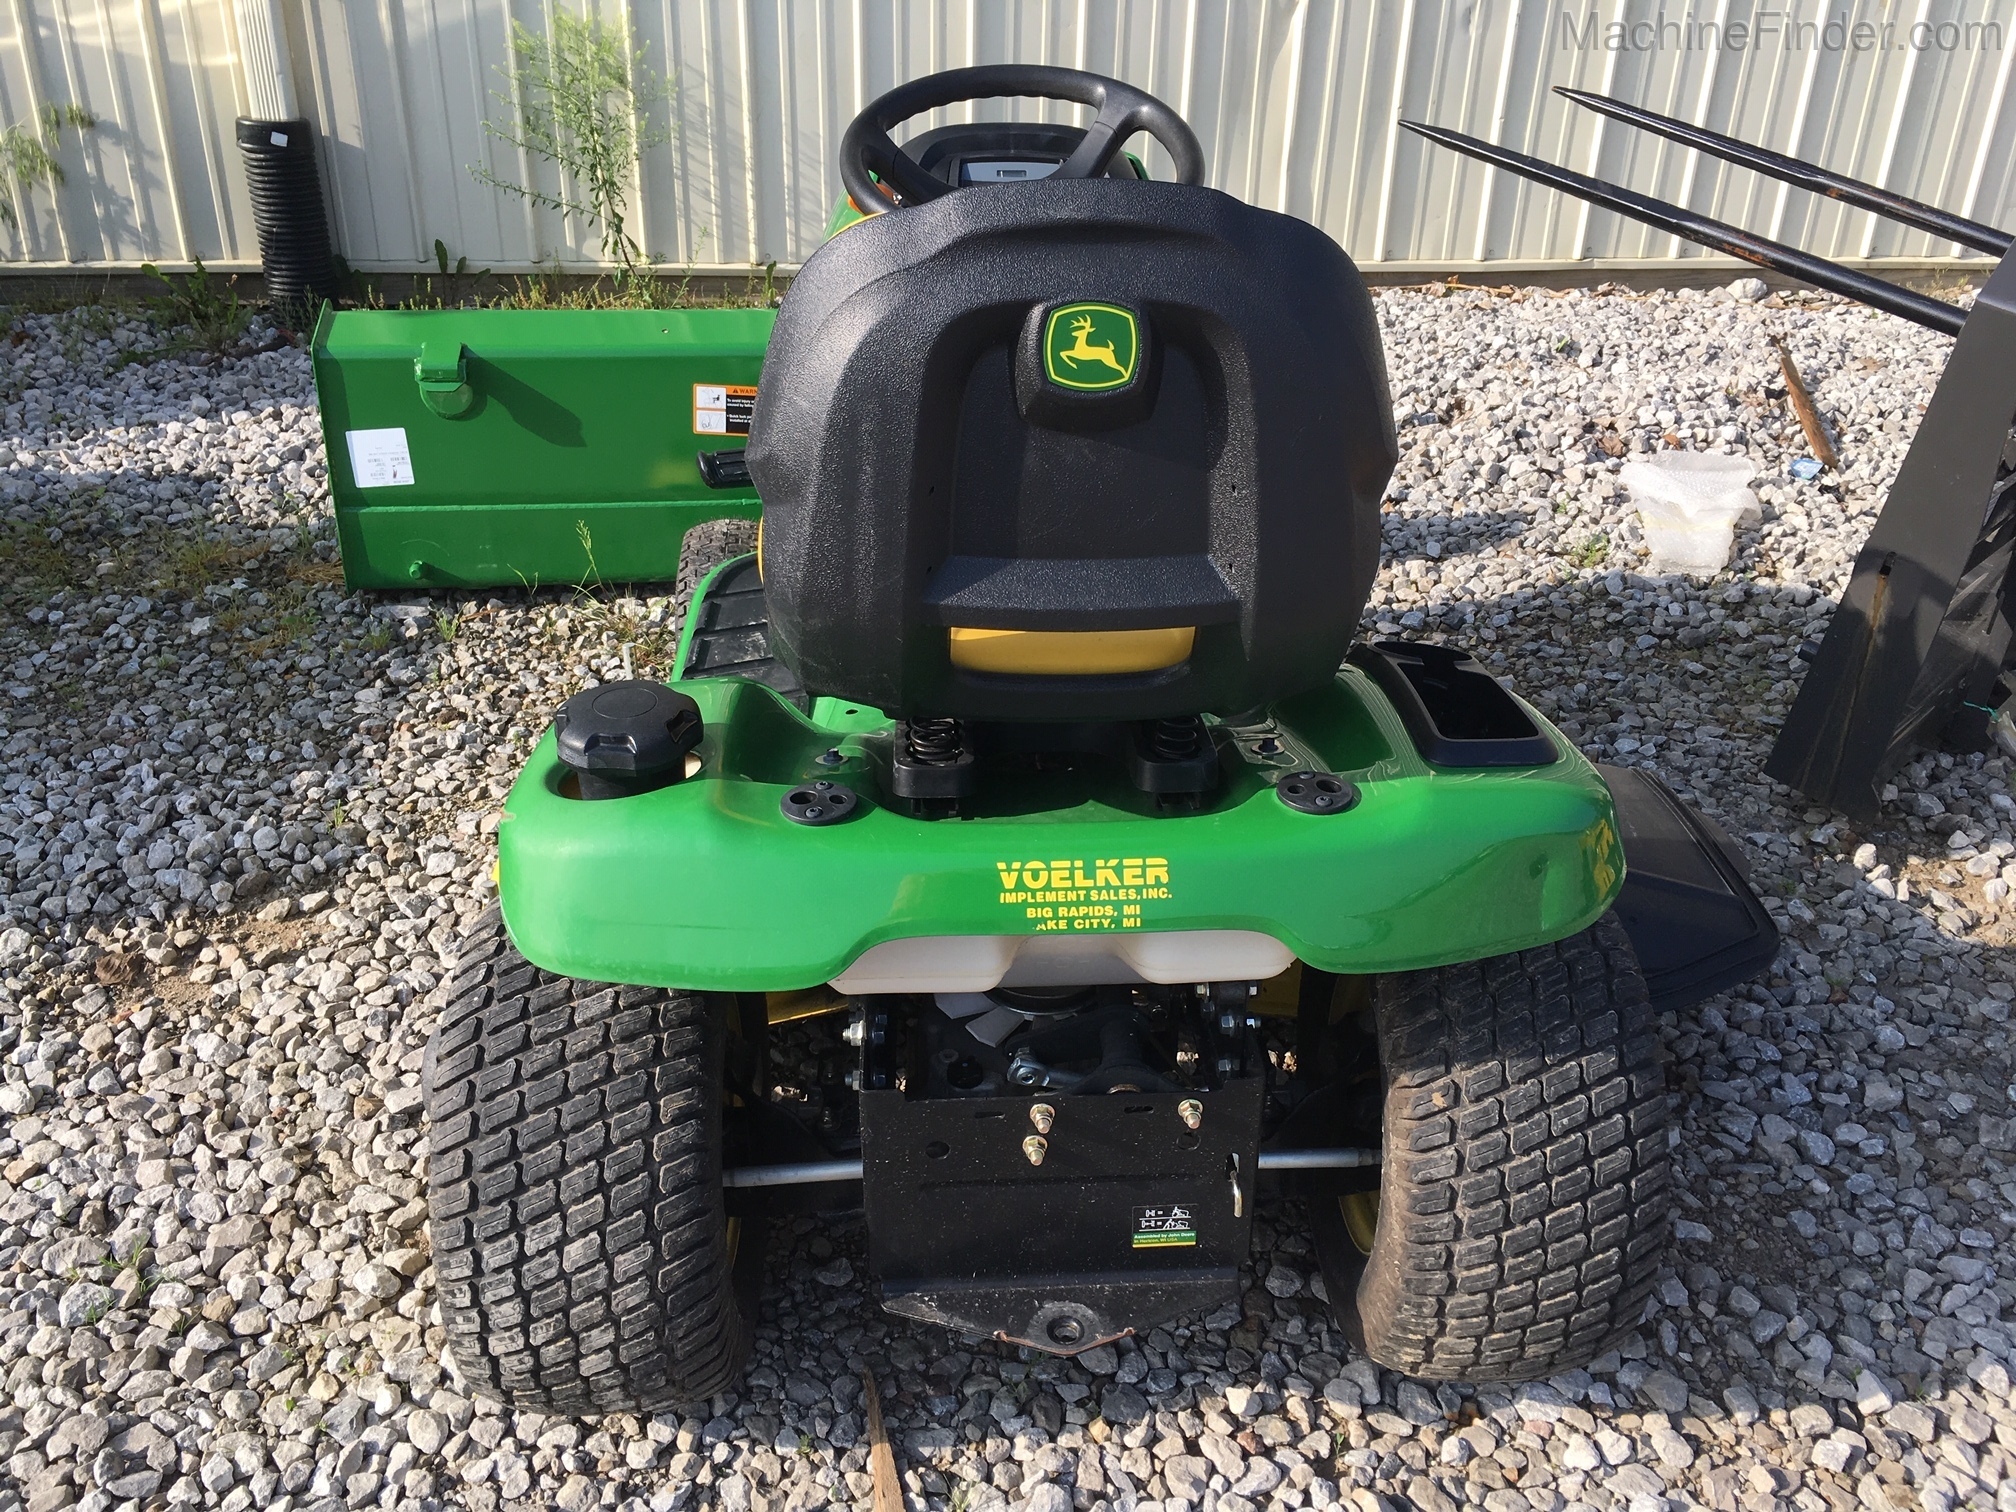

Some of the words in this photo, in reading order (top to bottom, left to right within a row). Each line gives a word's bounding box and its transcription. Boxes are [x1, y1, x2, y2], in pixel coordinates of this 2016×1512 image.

[997, 857, 1170, 890] VOELKER
[1000, 890, 1086, 903] IMPLEMENT
[1090, 889, 1141, 901] SALES,
[1142, 888, 1173, 900] INC.
[1026, 906, 1053, 918] BIG
[1058, 905, 1118, 917] RAPIDS,
[1123, 904, 1141, 915] MI
[1035, 919, 1068, 931] AKE
[1074, 918, 1116, 929] CITY,
[1122, 917, 1141, 928] MI
